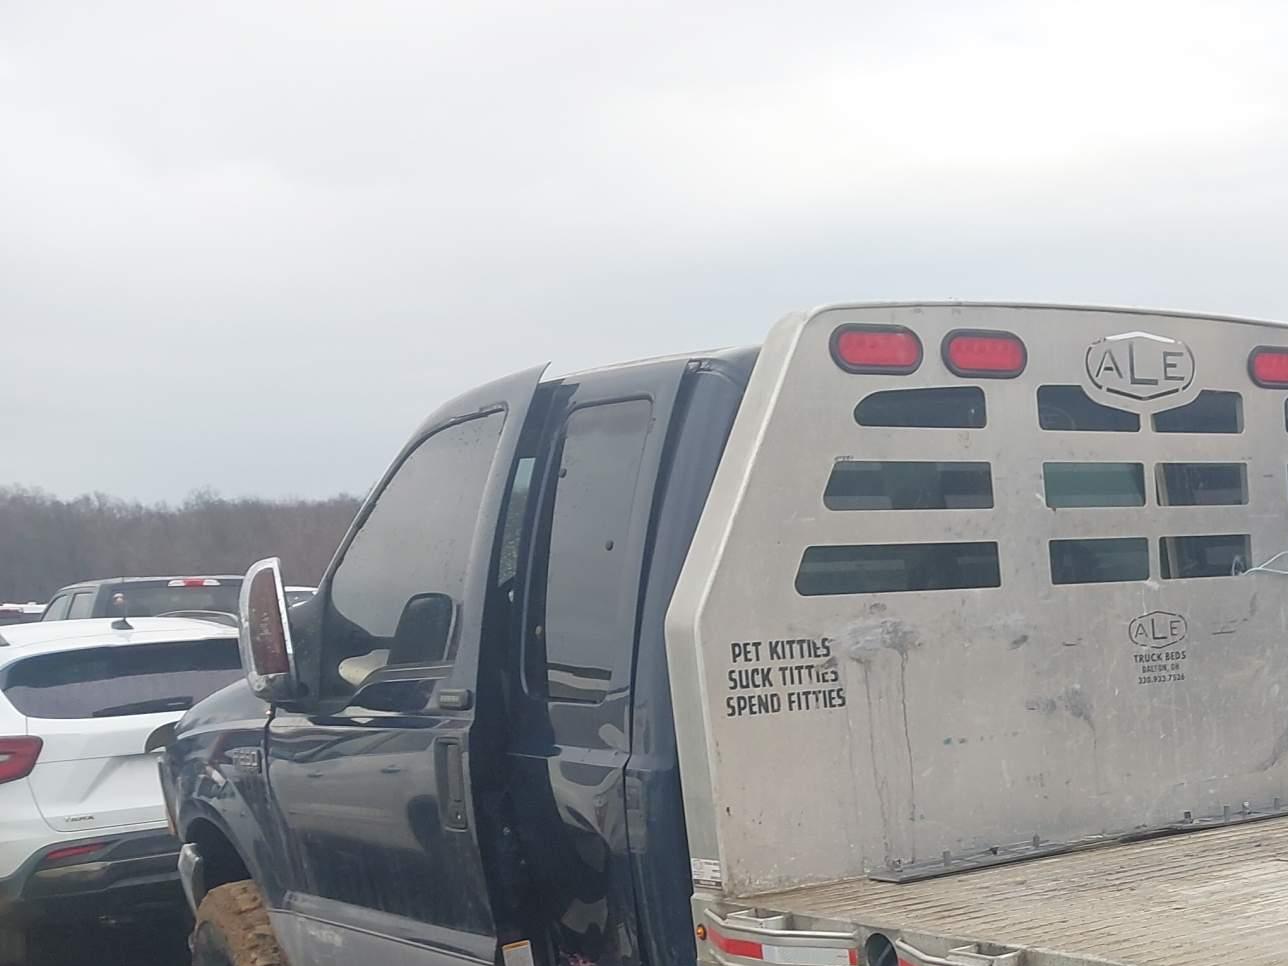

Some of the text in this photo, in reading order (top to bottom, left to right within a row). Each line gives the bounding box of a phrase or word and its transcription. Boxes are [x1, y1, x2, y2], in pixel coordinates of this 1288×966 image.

[1095, 342, 1185, 386] ALE
[1135, 618, 1181, 640] ALE
[731, 637, 831, 663] PET KITTIES
[1133, 650, 1187, 664] TRUCK BEDS
[728, 664, 839, 690] SUCK TITTIES
[726, 687, 846, 717] SPEND FITTIES
